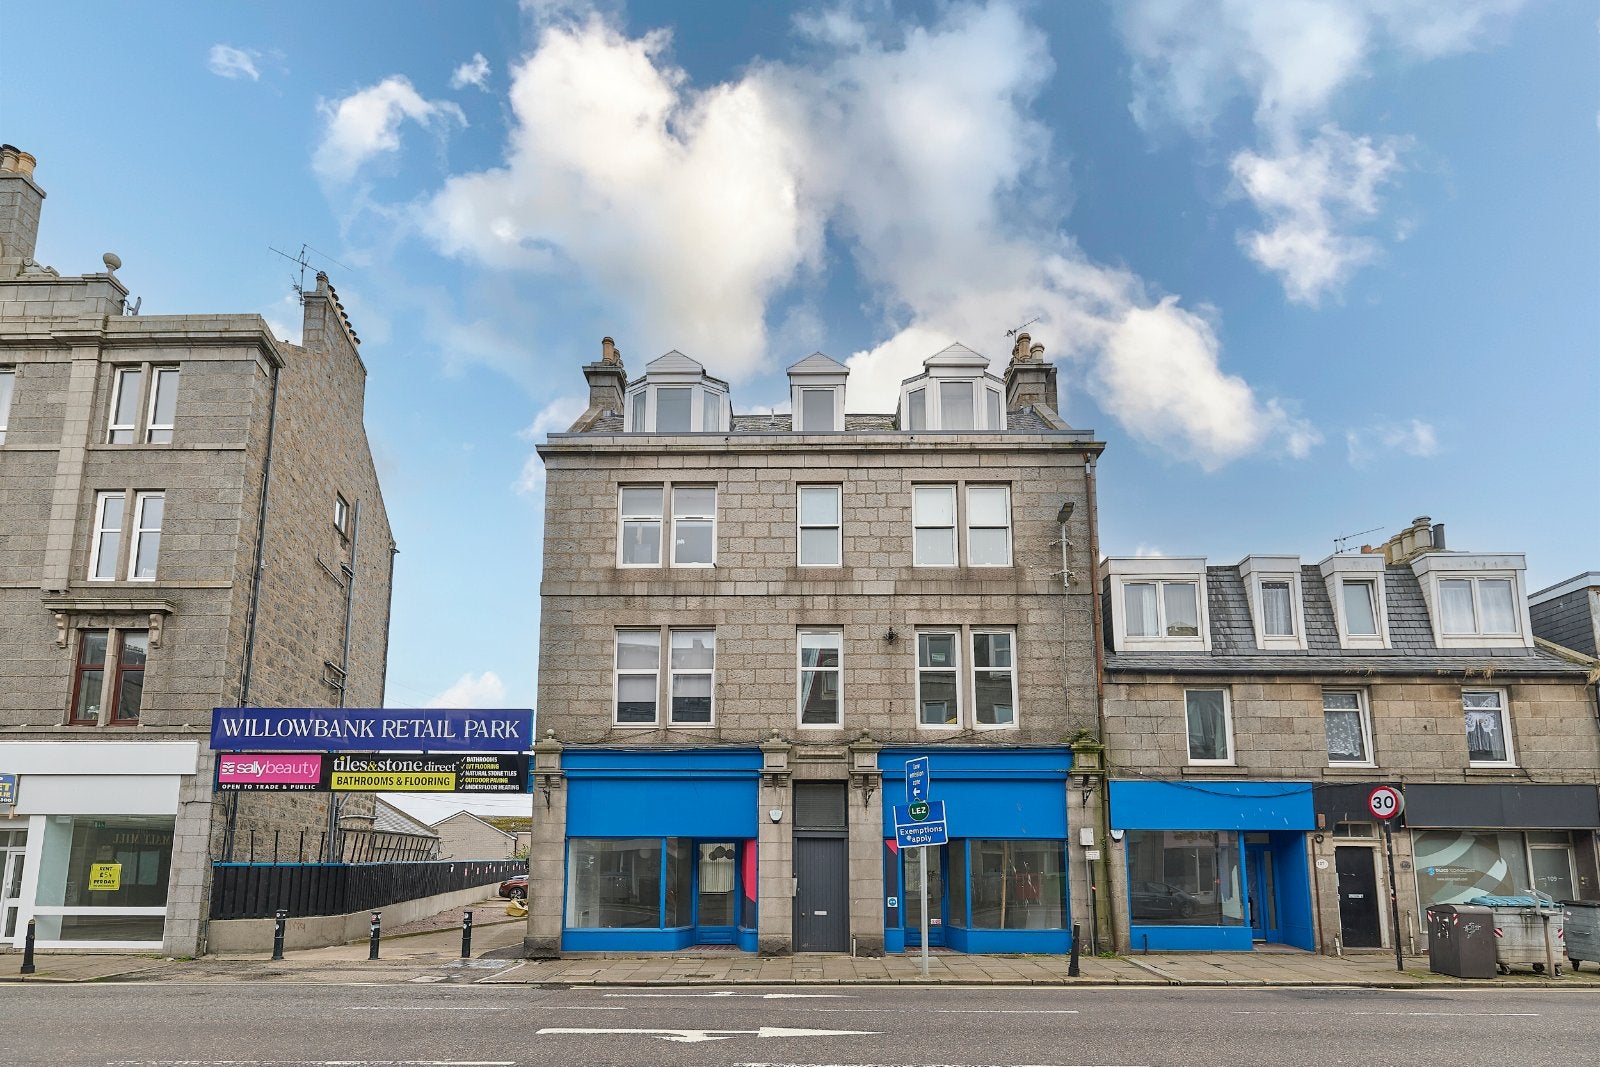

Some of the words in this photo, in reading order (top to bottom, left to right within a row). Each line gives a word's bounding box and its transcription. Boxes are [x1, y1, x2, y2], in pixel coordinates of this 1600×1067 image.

[222, 718, 375, 738] WILLOWBANK
[381, 719, 456, 738] RETAIL
[463, 719, 520, 739] PARK
[336, 776, 394, 786] BATHROOMS
[396, 776, 403, 786] &
[404, 777, 450, 786] FLOORING
[1373, 796, 1394, 809] 30
[912, 806, 926, 814] LEZ
[900, 826, 942, 836] Exemptions
[912, 834, 932, 844] apply
